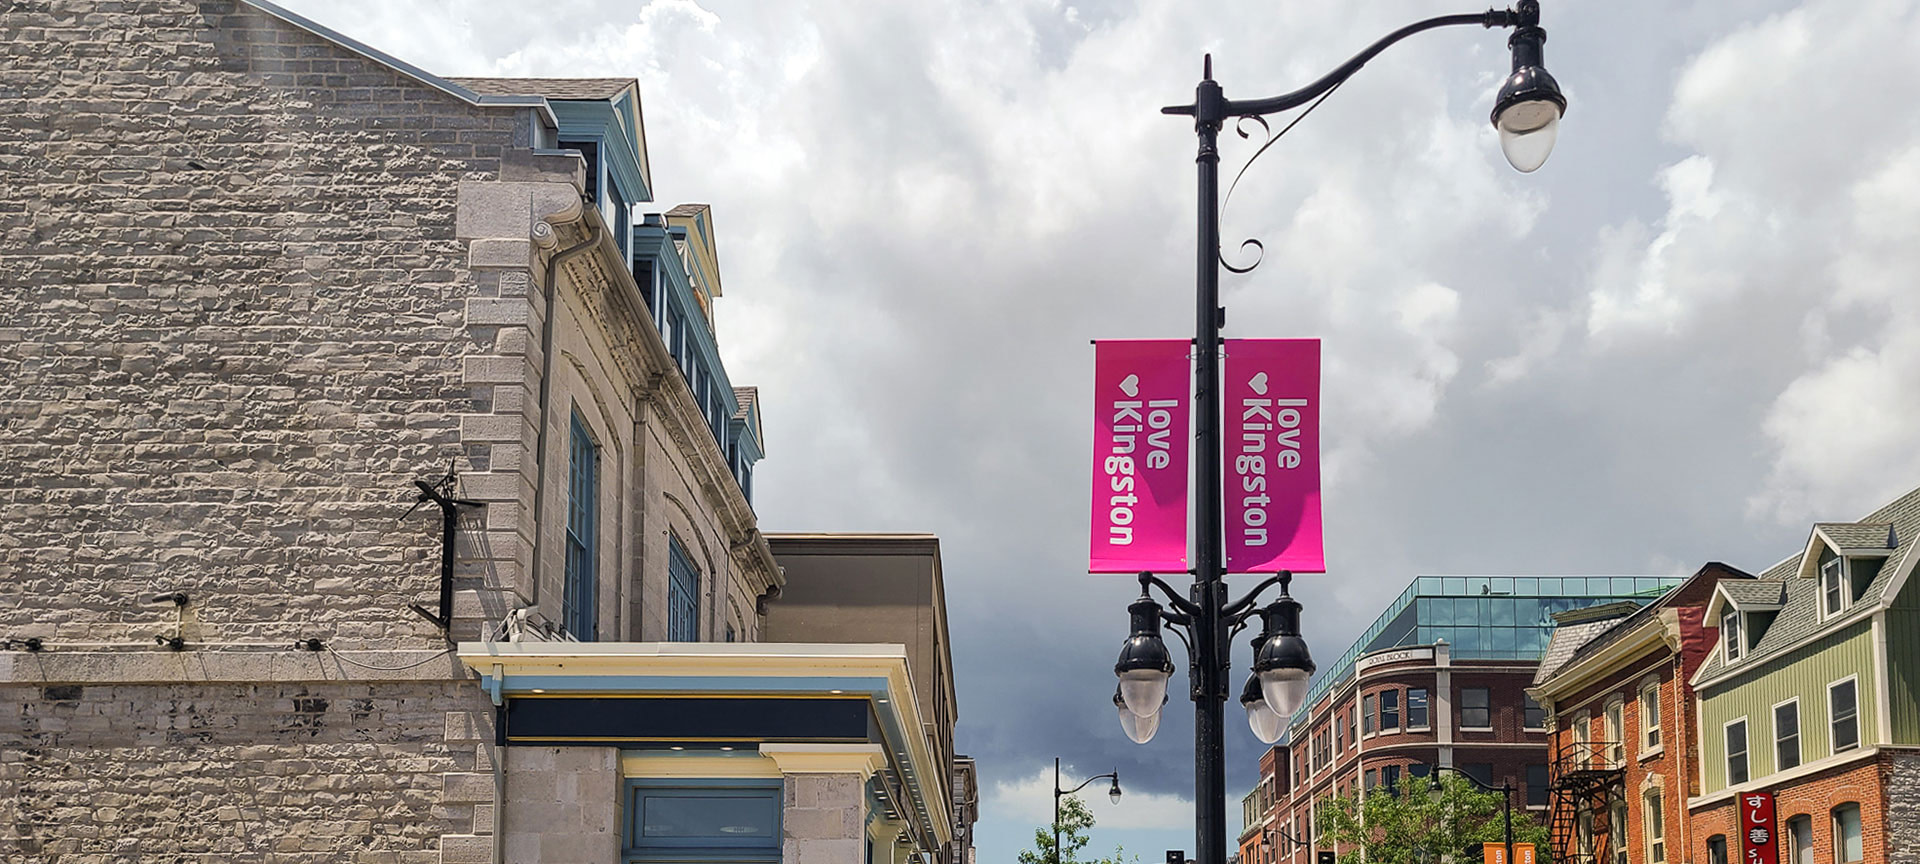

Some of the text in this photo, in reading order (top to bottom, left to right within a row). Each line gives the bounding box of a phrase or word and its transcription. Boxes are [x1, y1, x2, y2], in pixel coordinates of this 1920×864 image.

[1146, 400, 1178, 470] love
[1276, 399, 1308, 470] love
[1104, 401, 1143, 546] Kingston
[1235, 398, 1273, 547] Kingston
[1386, 652, 1410, 661] BLOCK
[1495, 849, 1503, 864] ton
[1524, 850, 1532, 864] ton
